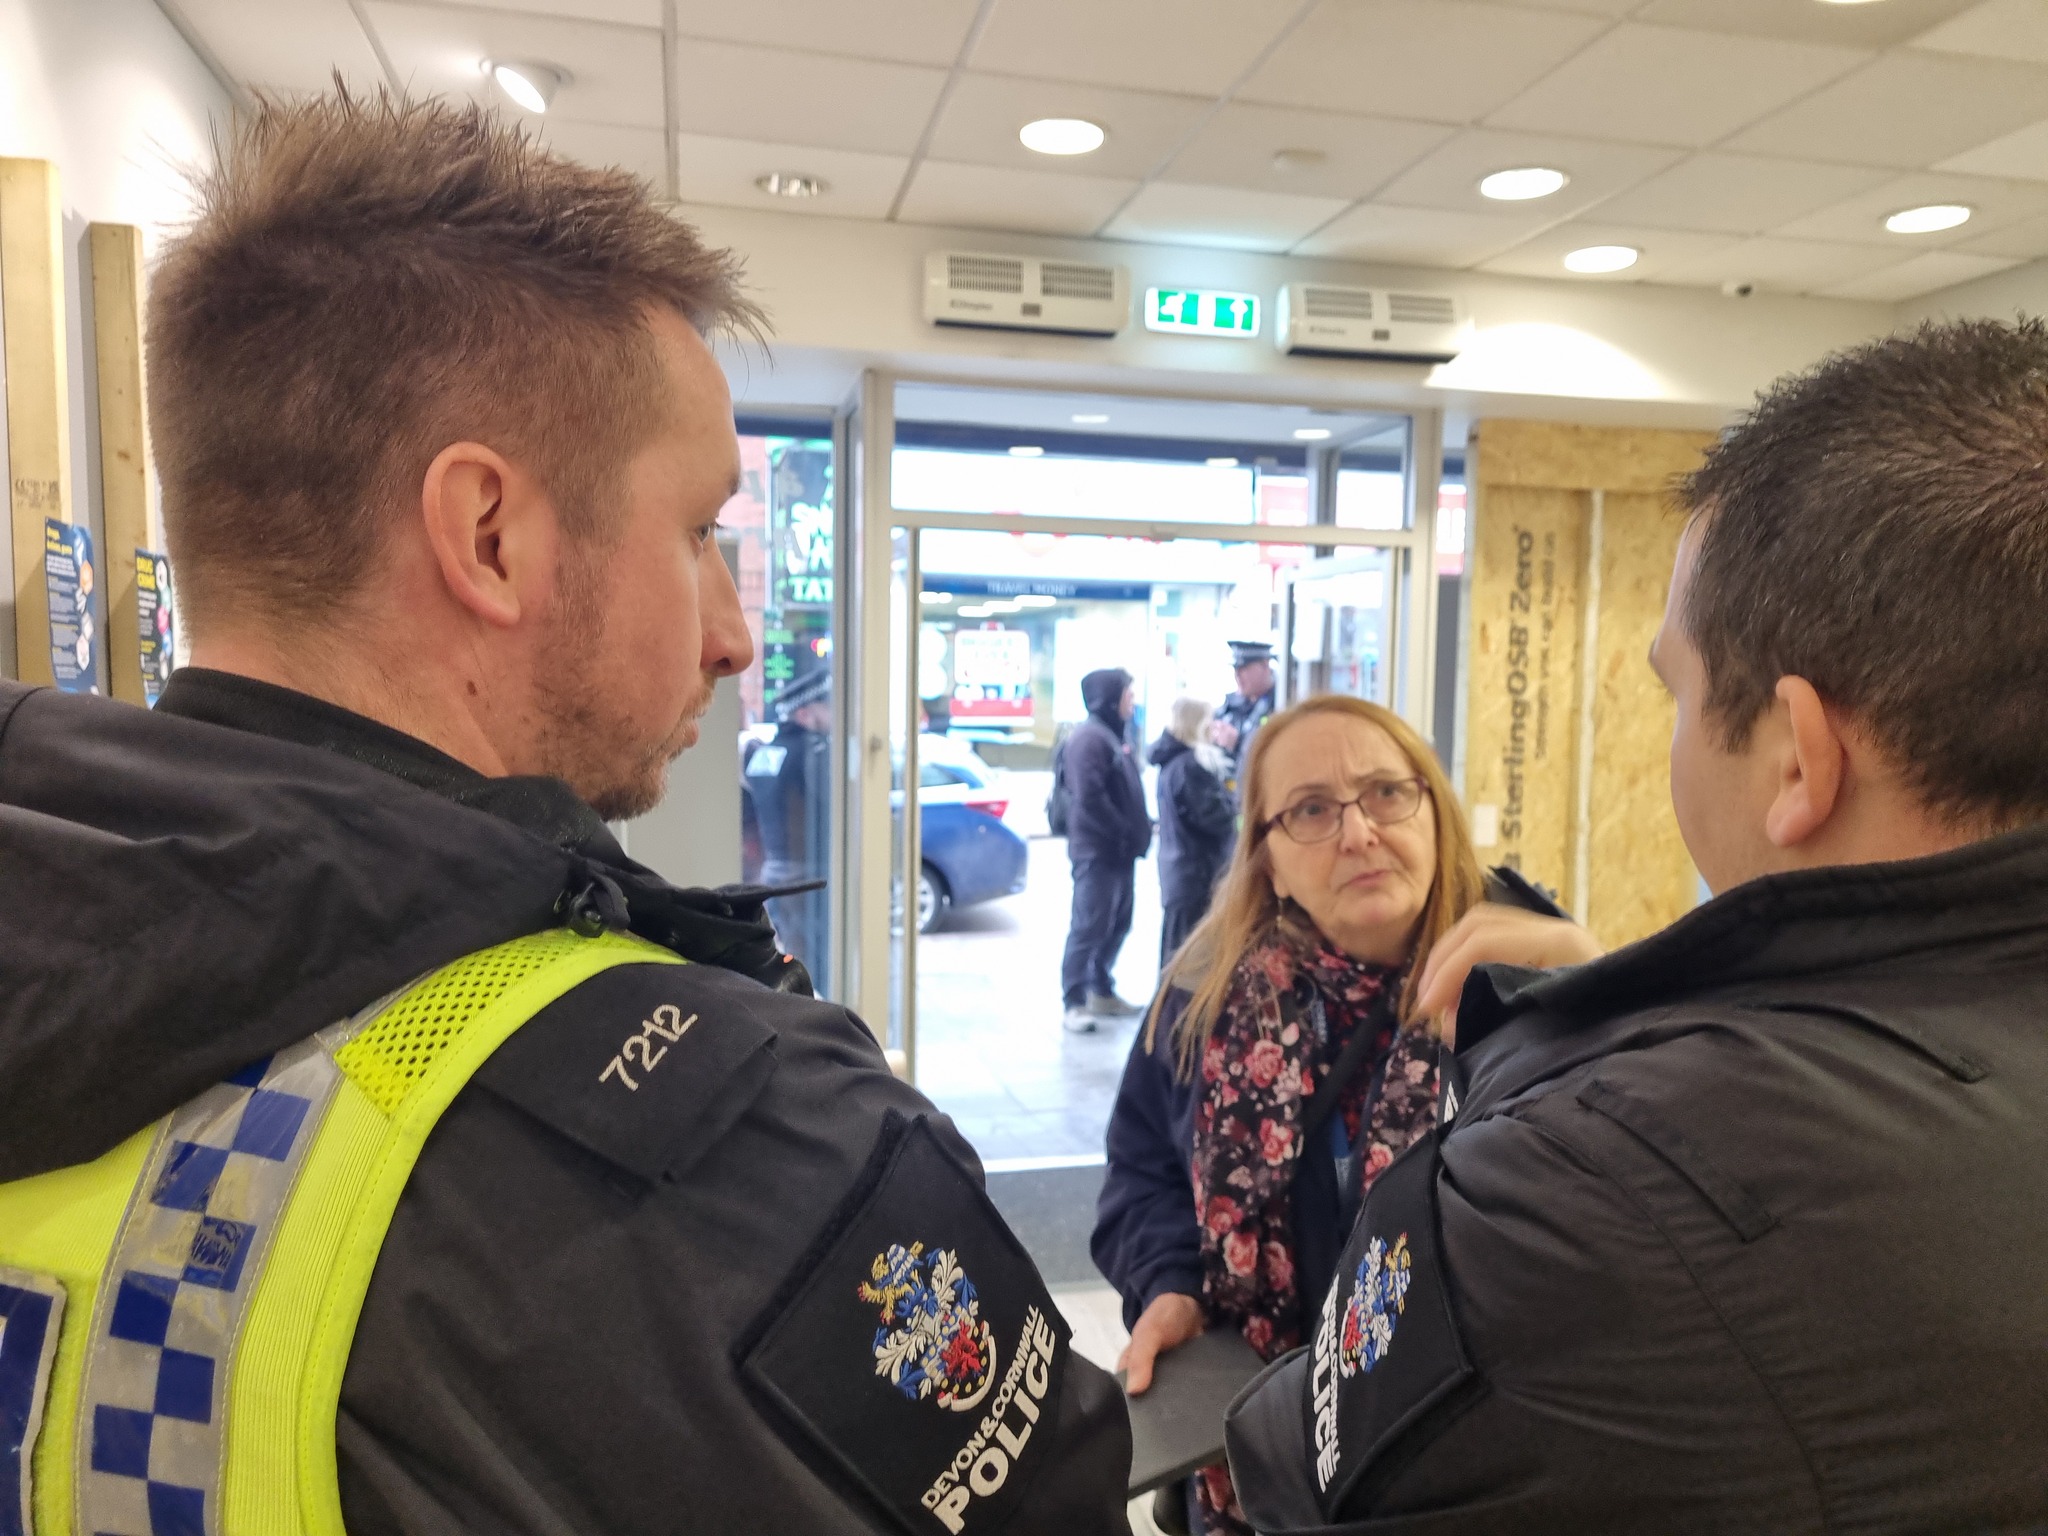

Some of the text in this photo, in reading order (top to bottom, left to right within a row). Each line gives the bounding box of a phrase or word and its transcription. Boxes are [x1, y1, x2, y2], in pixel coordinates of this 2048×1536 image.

[1509, 531, 1534, 614] Zero
[598, 1004, 698, 1092] 7212
[920, 1304, 1039, 1510] DEVON & CORNWALL
[933, 1312, 1056, 1536] POLICE
